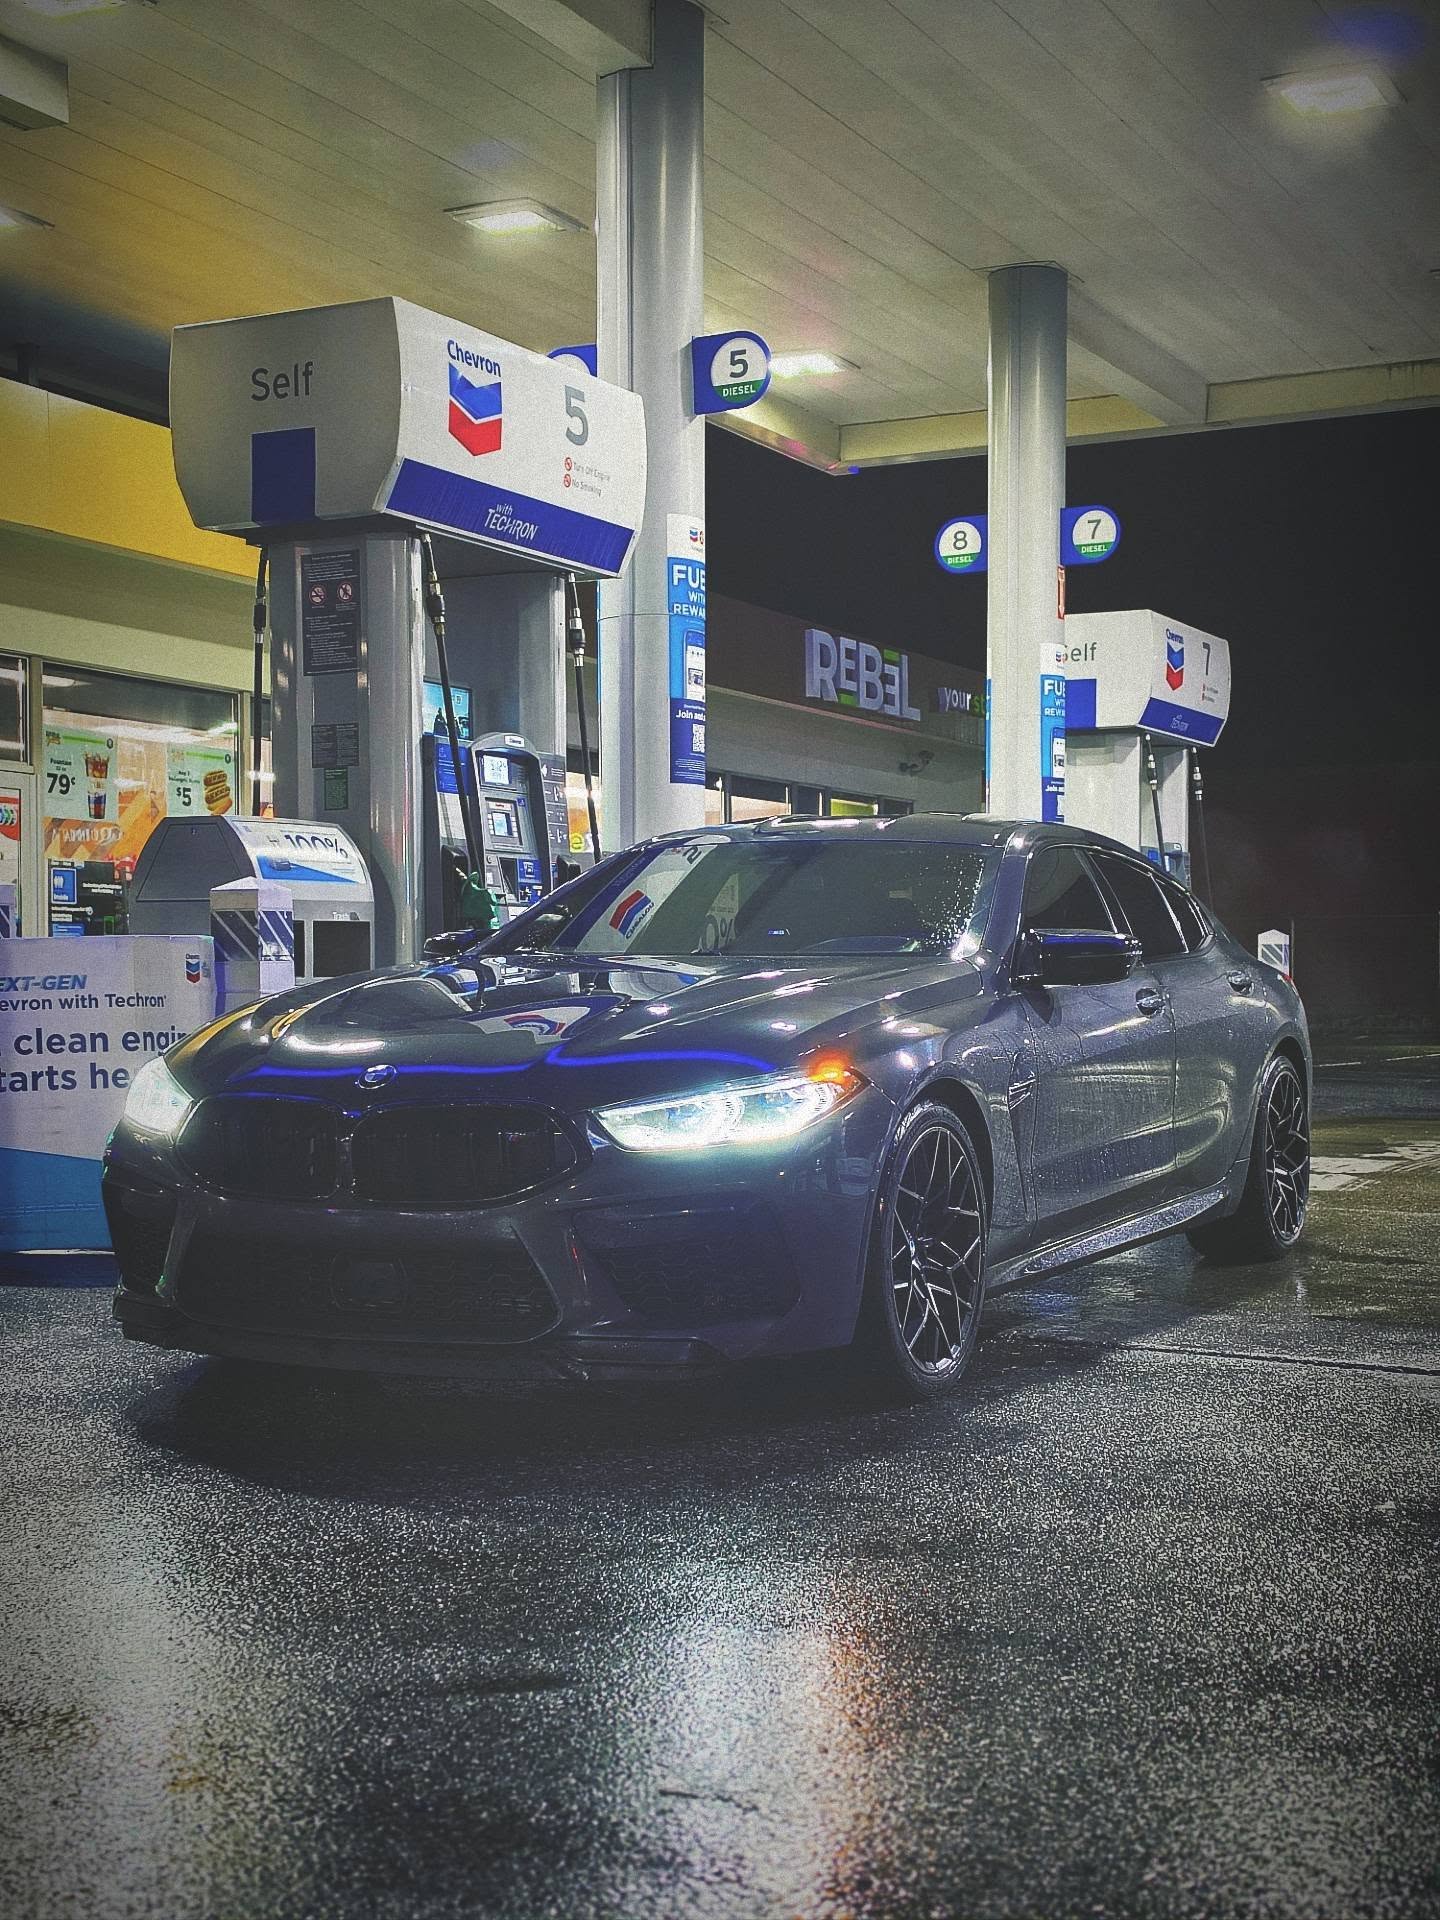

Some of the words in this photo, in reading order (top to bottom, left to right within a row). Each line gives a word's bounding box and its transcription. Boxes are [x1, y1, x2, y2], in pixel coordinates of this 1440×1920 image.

[447, 339, 502, 378] Chevron
[729, 349, 749, 378] 5
[251, 361, 314, 401] Self
[722, 384, 756, 397] DIESEL
[564, 384, 589, 446] 5
[496, 503, 513, 516] with
[484, 508, 539, 541] TECHRON
[1087, 518, 1102, 540] 7
[952, 530, 968, 550] 8
[1080, 544, 1108, 554] DIESEL
[947, 555, 974, 564] DIESEL
[1202, 641, 1211, 676] 7
[804, 628, 921, 722] REBEL
[943, 686, 972, 712] your
[676, 704, 693, 720] Join
[176, 786, 192, 807] $5
[59, 994, 99, 1010] with
[13, 1027, 109, 1056] clean
